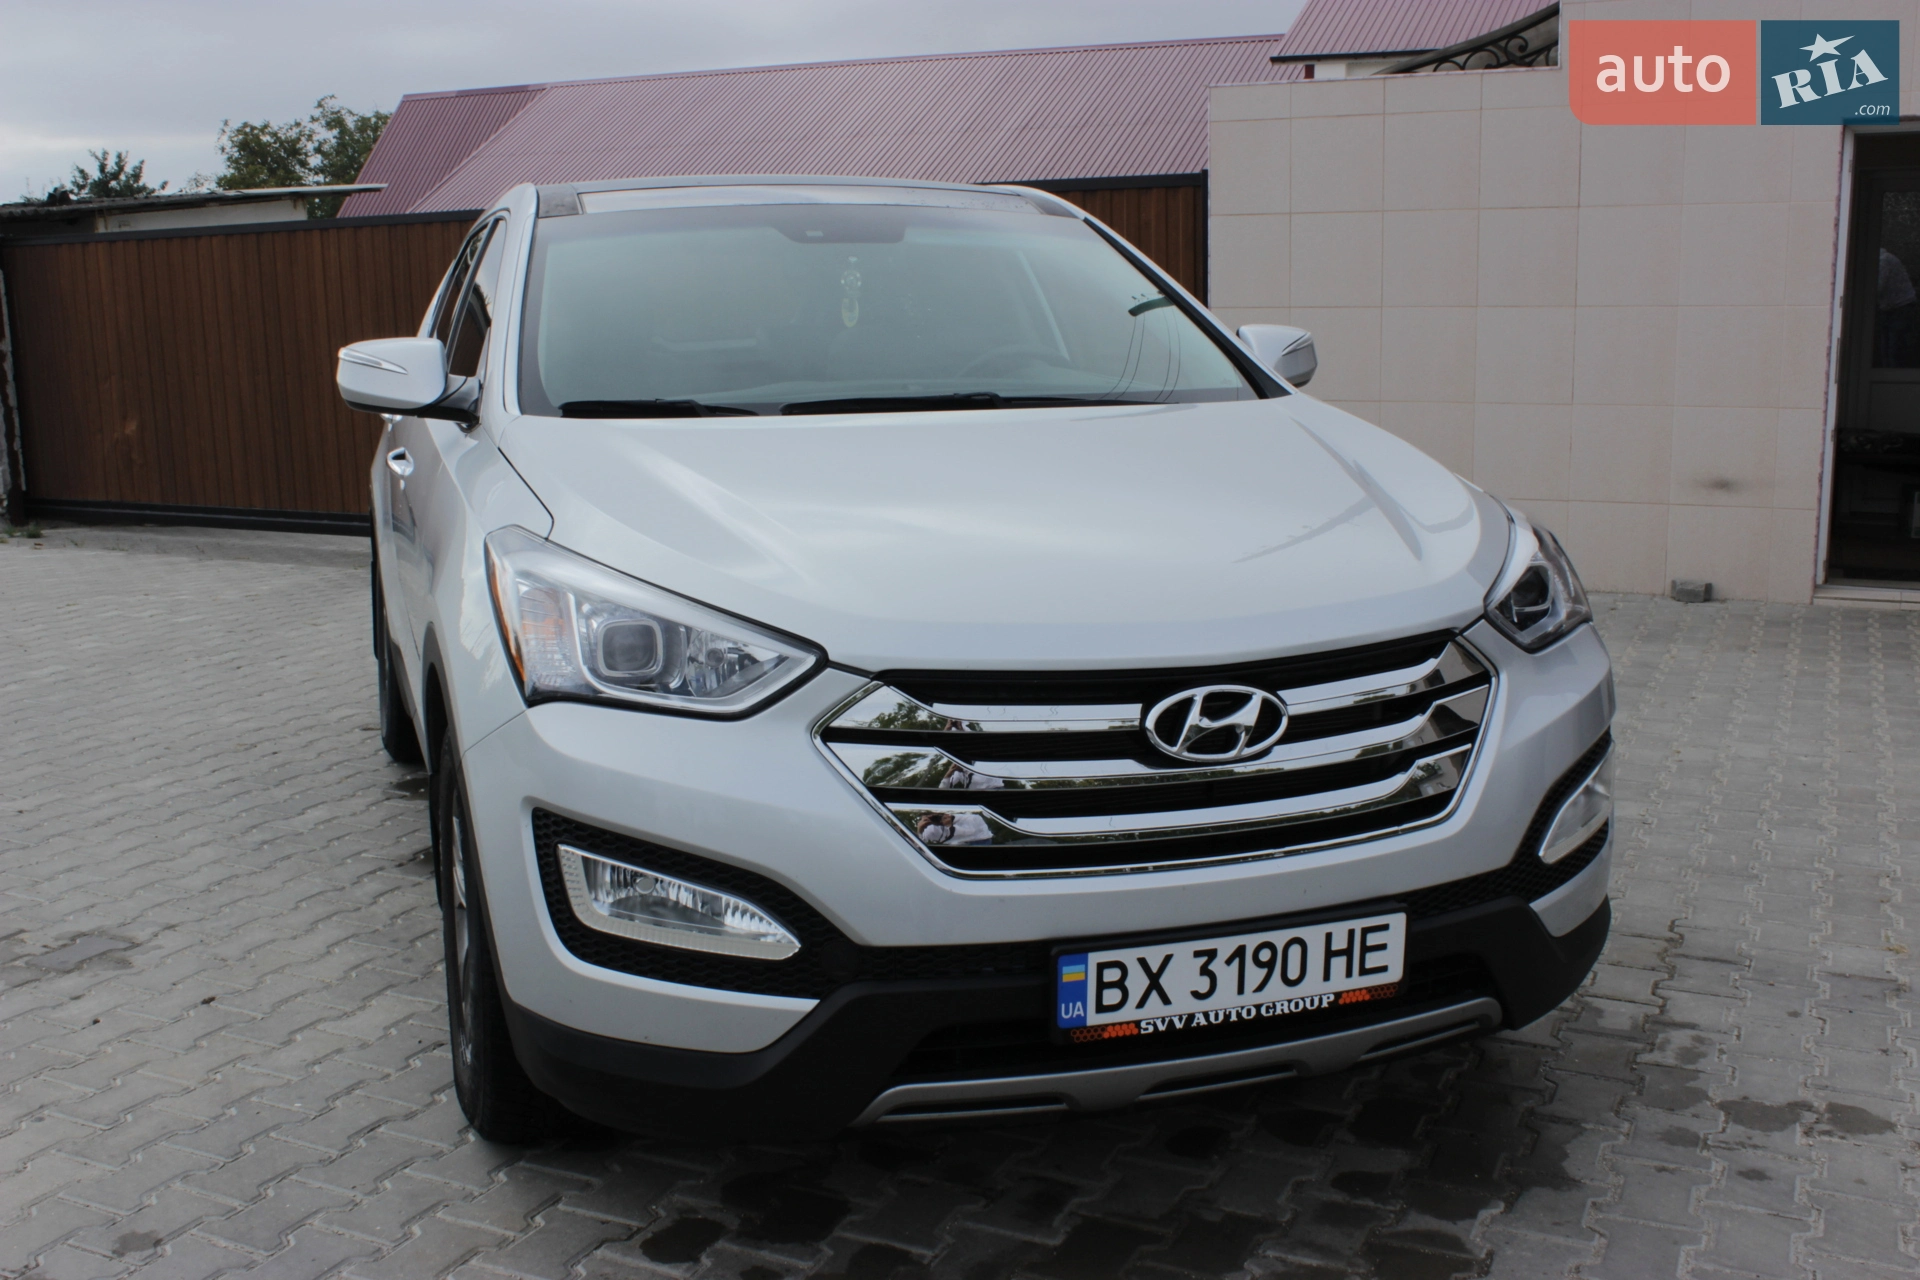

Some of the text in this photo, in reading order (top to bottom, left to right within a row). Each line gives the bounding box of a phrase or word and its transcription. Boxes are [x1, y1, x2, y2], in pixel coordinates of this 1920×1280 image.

[1095, 923, 1390, 1015] BX 3190 HE
[1061, 1001, 1085, 1019] UA
[1140, 993, 1335, 1034] SVV AUTO GROUP
